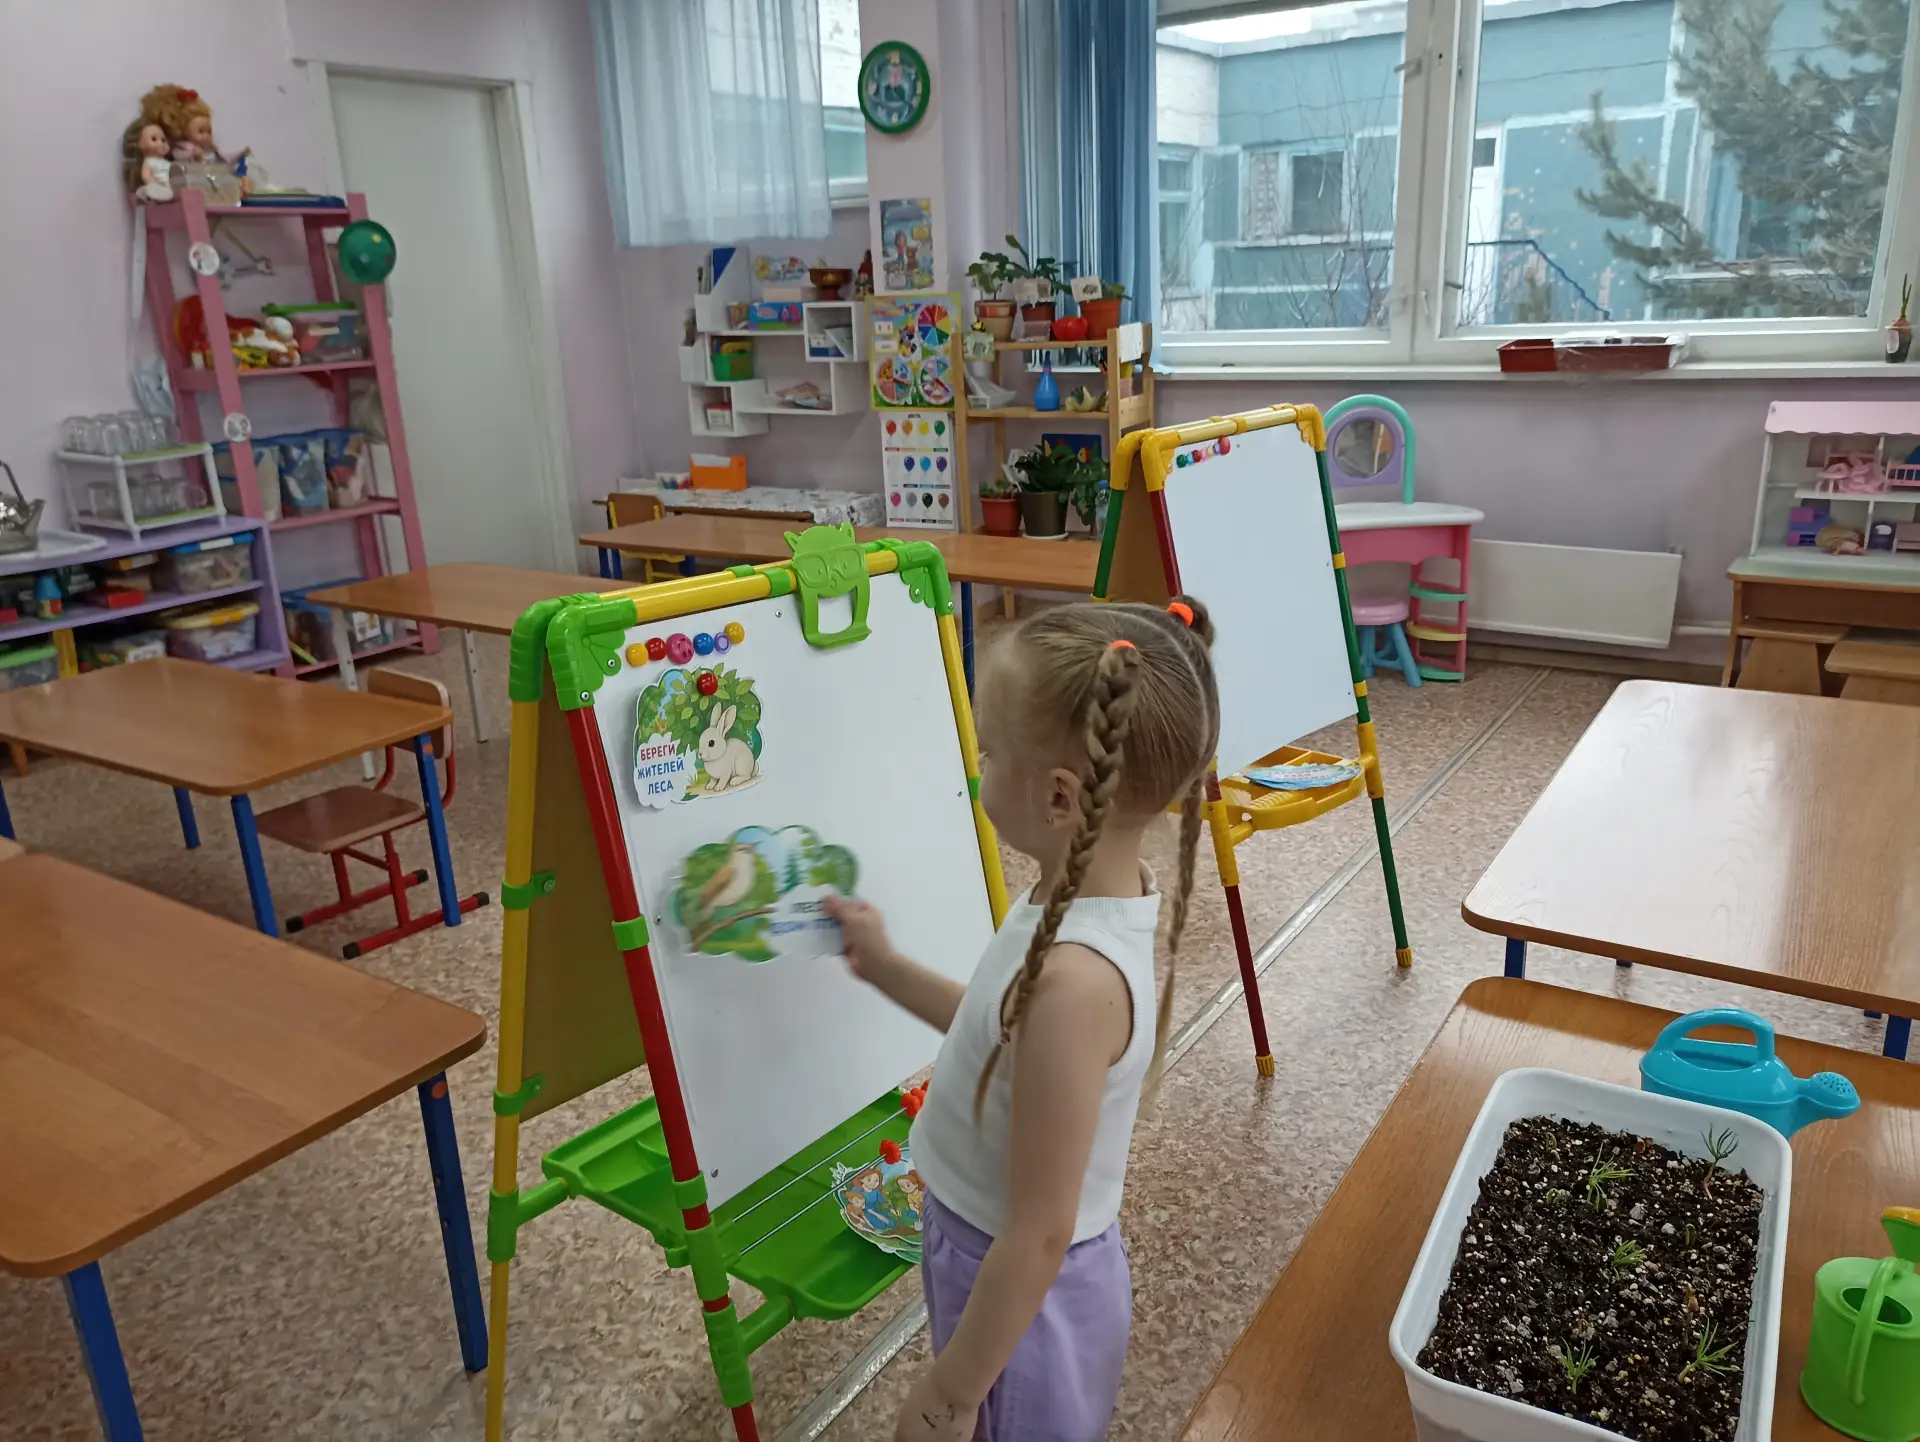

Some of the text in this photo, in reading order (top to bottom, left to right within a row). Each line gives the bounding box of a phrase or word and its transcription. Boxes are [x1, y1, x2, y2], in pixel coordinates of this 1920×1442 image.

[640, 744, 676, 761] БЕРЕГИ
[637, 757, 684, 780] ЖИТЕЛЕЙ
[647, 780, 674, 795] ЛЕСА
